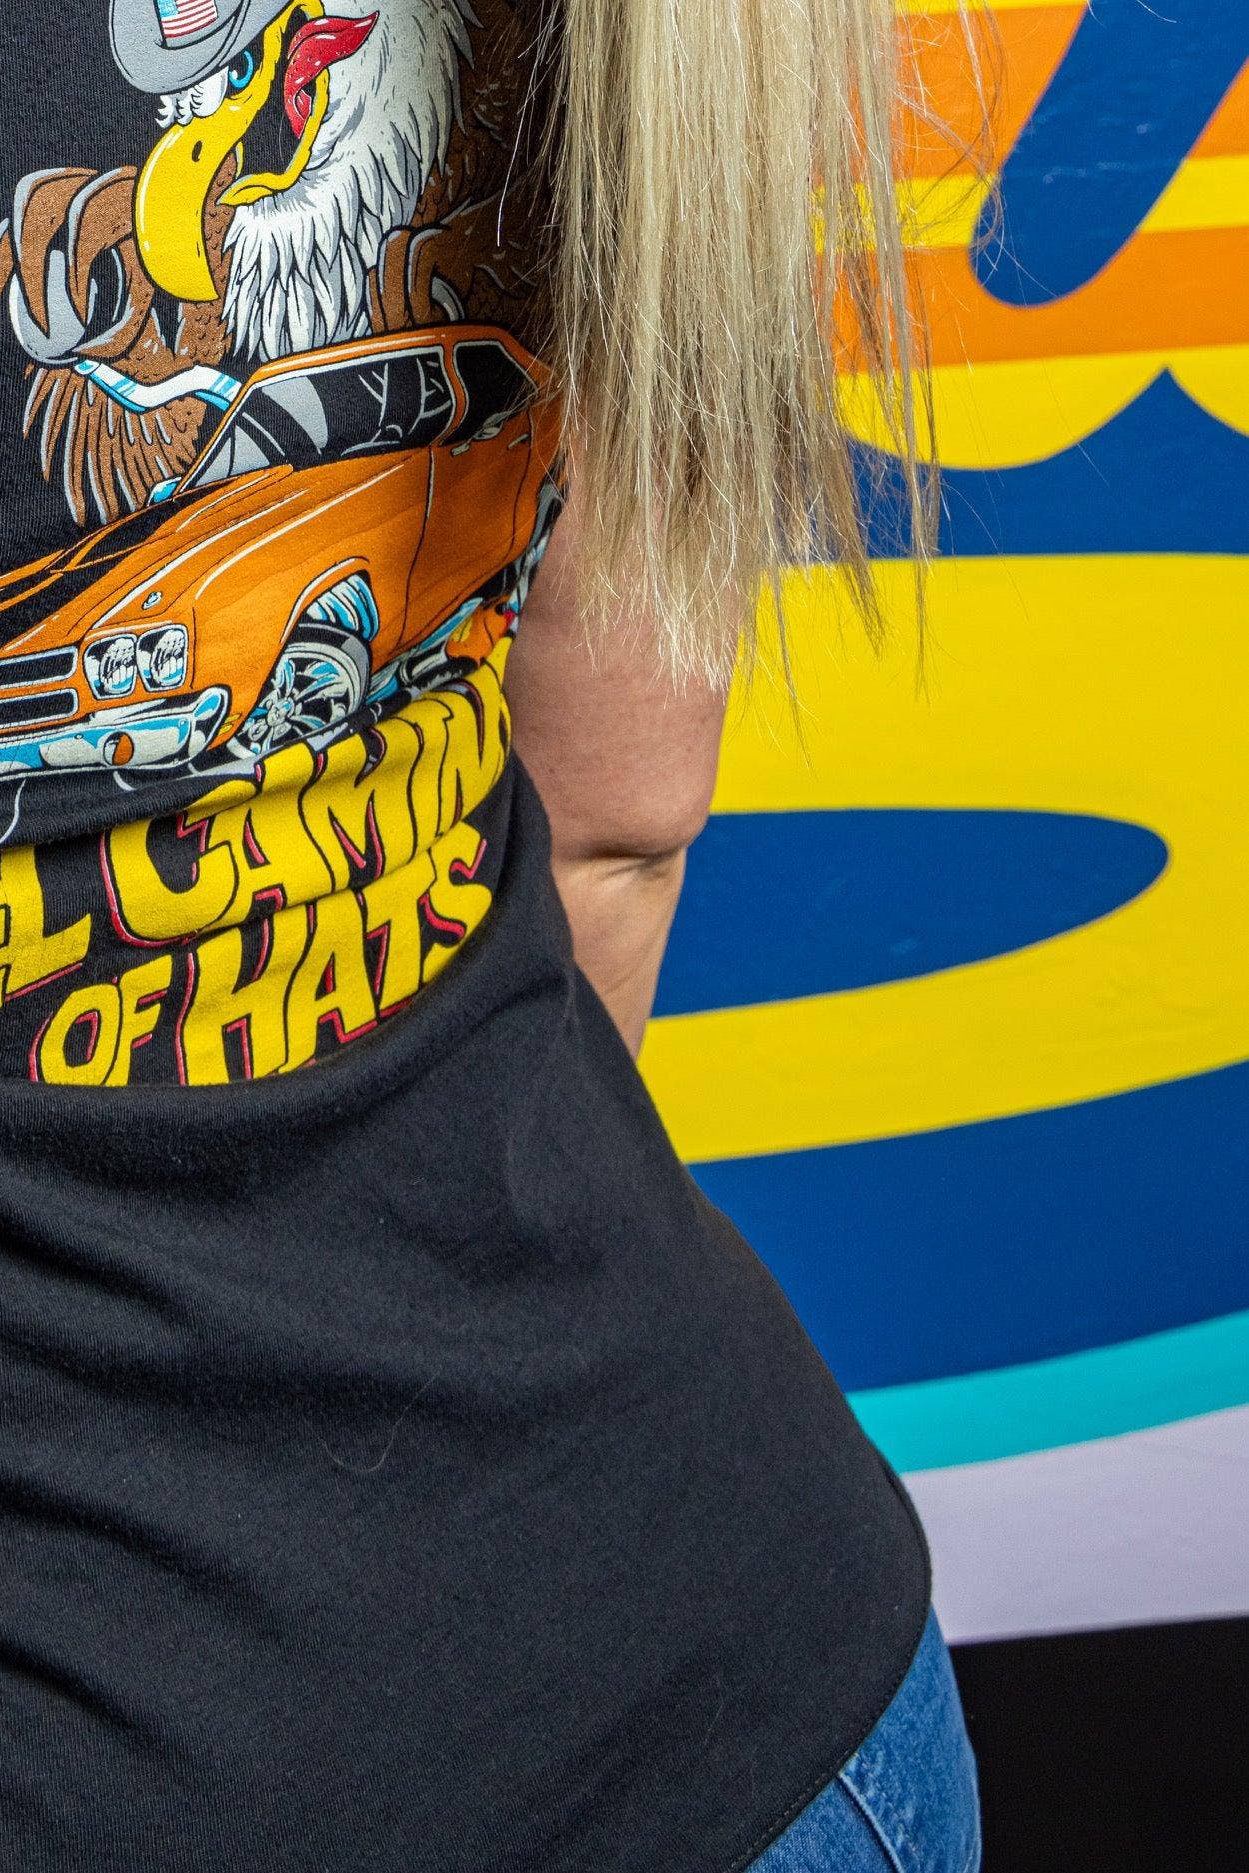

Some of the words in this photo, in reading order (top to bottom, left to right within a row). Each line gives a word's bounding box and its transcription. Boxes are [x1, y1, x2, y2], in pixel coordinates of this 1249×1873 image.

[101, 636, 511, 948] CAMIN
[28, 956, 172, 1087] OF
[178, 818, 493, 1086] HATS
